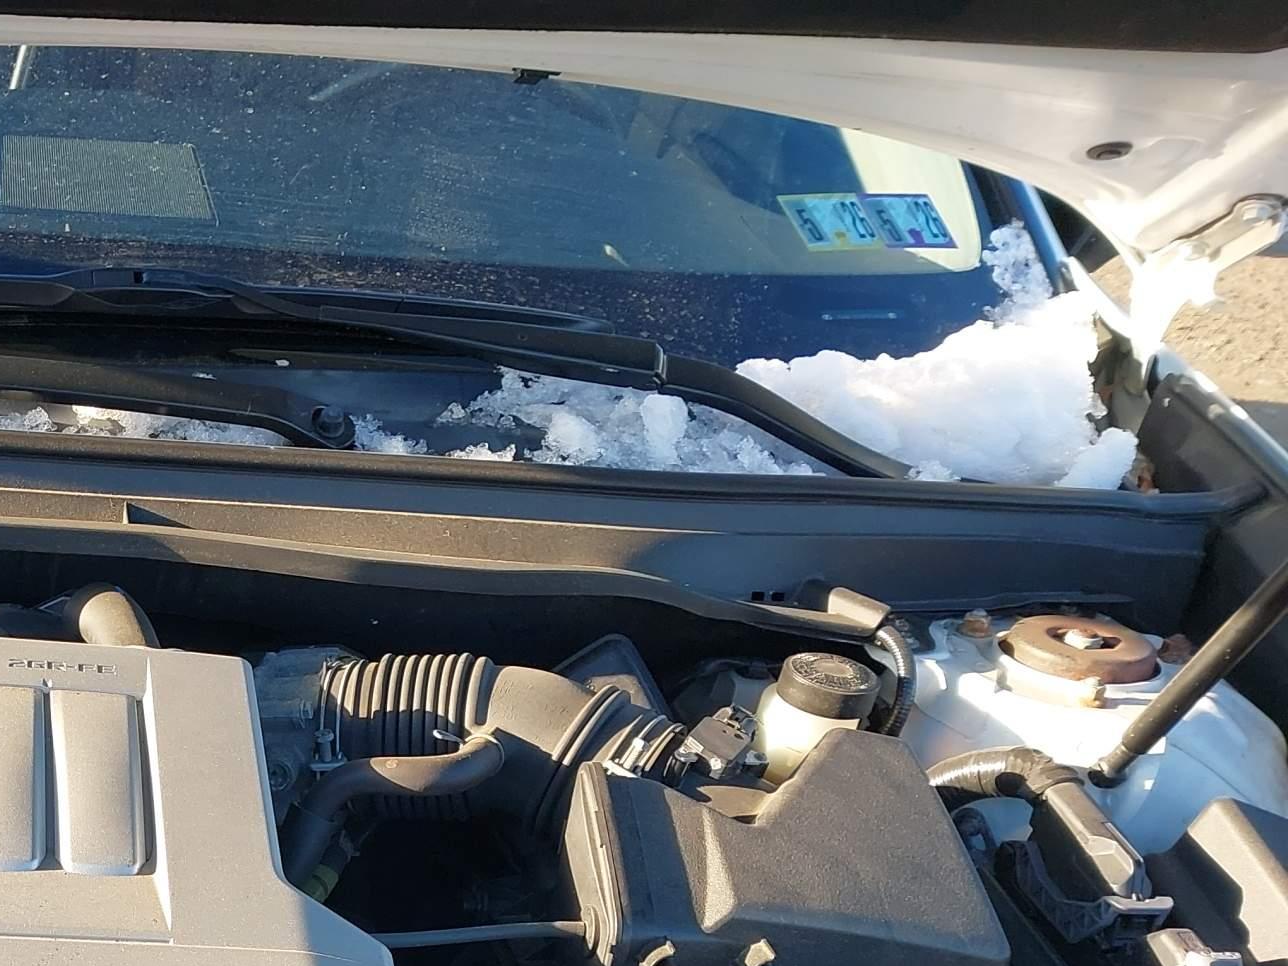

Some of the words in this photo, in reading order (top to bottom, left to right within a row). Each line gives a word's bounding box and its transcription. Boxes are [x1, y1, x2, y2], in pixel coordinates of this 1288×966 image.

[796, 208, 825, 242] 5
[876, 208, 903, 242] 5
[8, 658, 118, 675] 2GR-FE
